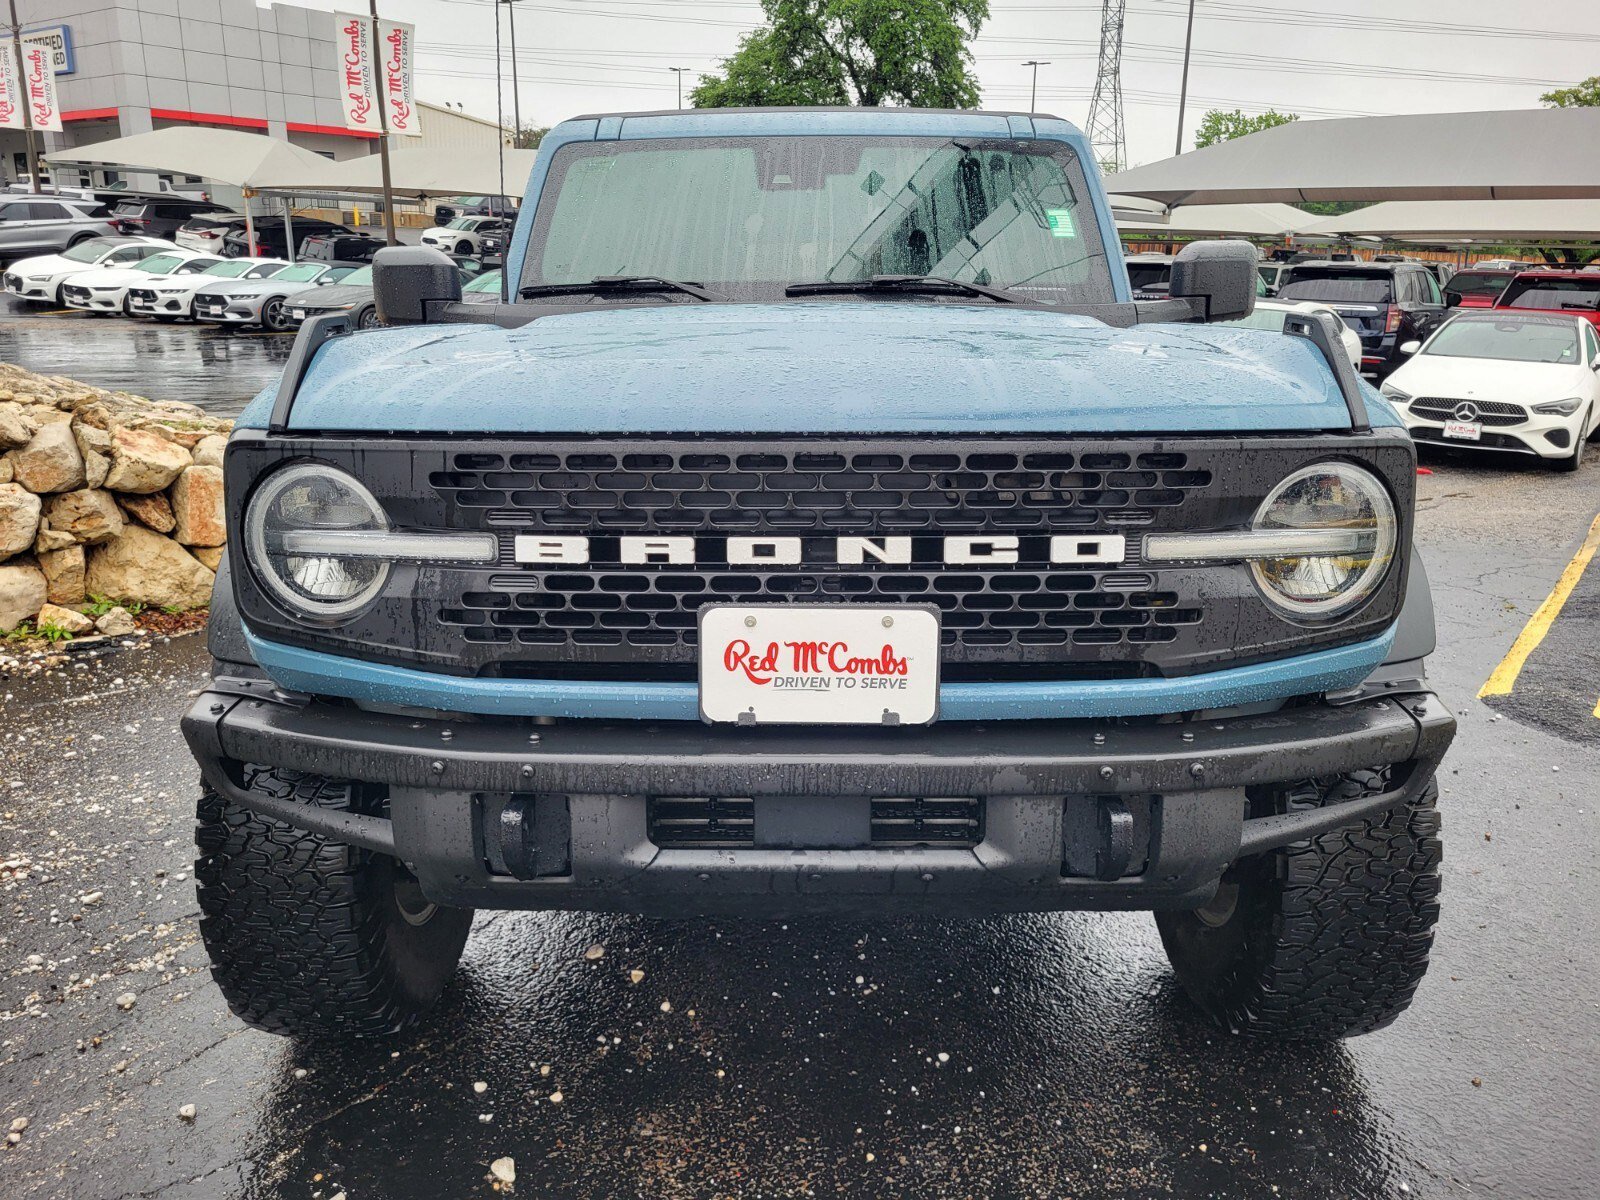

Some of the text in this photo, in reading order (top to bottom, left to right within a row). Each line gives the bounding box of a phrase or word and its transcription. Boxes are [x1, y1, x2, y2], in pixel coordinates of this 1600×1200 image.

[344, 20, 371, 124] Red McCombs
[361, 50, 368, 62] TO
[401, 30, 410, 104] DRIVEN TO SERVE
[27, 49, 52, 126] Red McCombs
[43, 71, 49, 81] TO
[361, 66, 370, 98] DRIVEN
[387, 28, 410, 129] Red McCombs
[514, 534, 1126, 565] BRONCO
[723, 639, 908, 685] Red McCombs
[773, 676, 908, 690] DRIVEN TO SERVE
